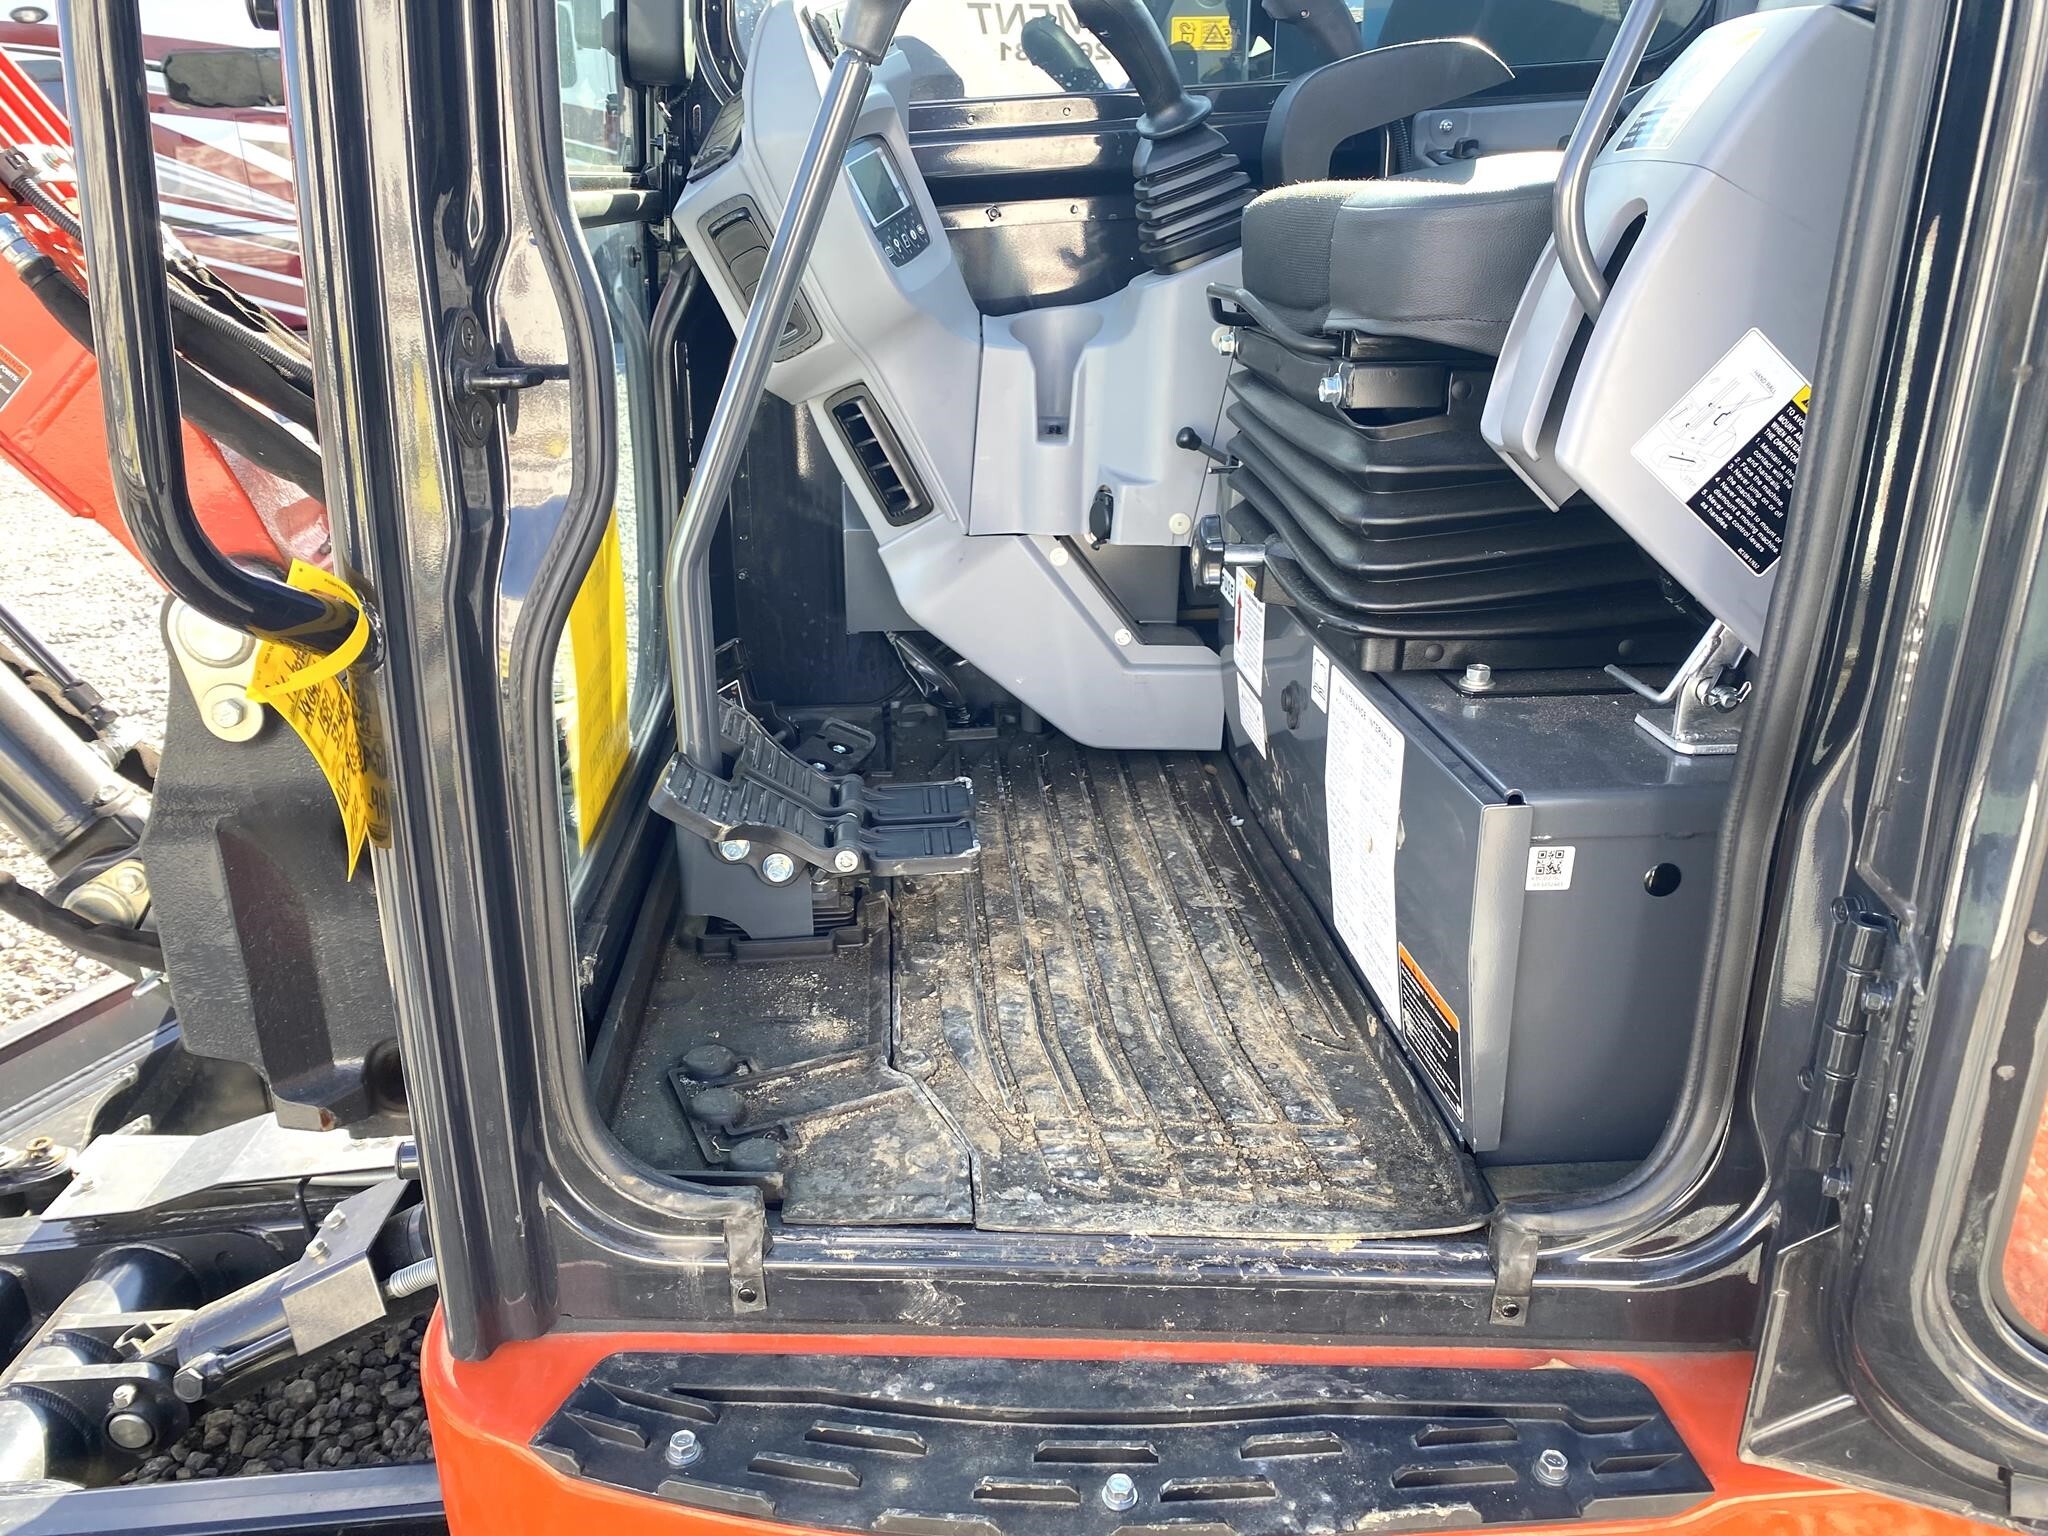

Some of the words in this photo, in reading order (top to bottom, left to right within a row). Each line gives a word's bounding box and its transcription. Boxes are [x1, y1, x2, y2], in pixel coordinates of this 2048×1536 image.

[1778, 415, 1796, 433] MOUNT
[1794, 433, 1803, 441] AN
[1786, 406, 1795, 416] TO
[1793, 416, 1806, 427] AVO
[1764, 428, 1773, 440] THE
[1771, 421, 1787, 438] WHEN
[1785, 436, 1801, 452] ENTER
[1746, 457, 1758, 468] and
[1753, 450, 1773, 469] contact
[1772, 468, 1783, 479] with
[1783, 479, 1792, 489] the
[1760, 443, 1782, 466] Maintain
[1781, 462, 1786, 470] a
[1727, 475, 1736, 485] the
[1740, 462, 1753, 476] Face
[1753, 475, 1762, 485] the
[1700, 501, 1708, 510] as
[1733, 469, 1750, 486] Never
[1747, 484, 1762, 498] jump
[1761, 498, 1769, 506] on
[1774, 510, 1783, 518] off
[1714, 489, 1738, 512] dismount
[1740, 515, 1758, 533] moving
[1720, 481, 1736, 498] Never
[1735, 498, 1755, 517] attempt
[1760, 522, 1776, 538] mount
[1707, 494, 1723, 511] Never
[1722, 510, 1732, 520] use
[1732, 520, 1750, 538] control
[1749, 537, 1765, 552] levers
